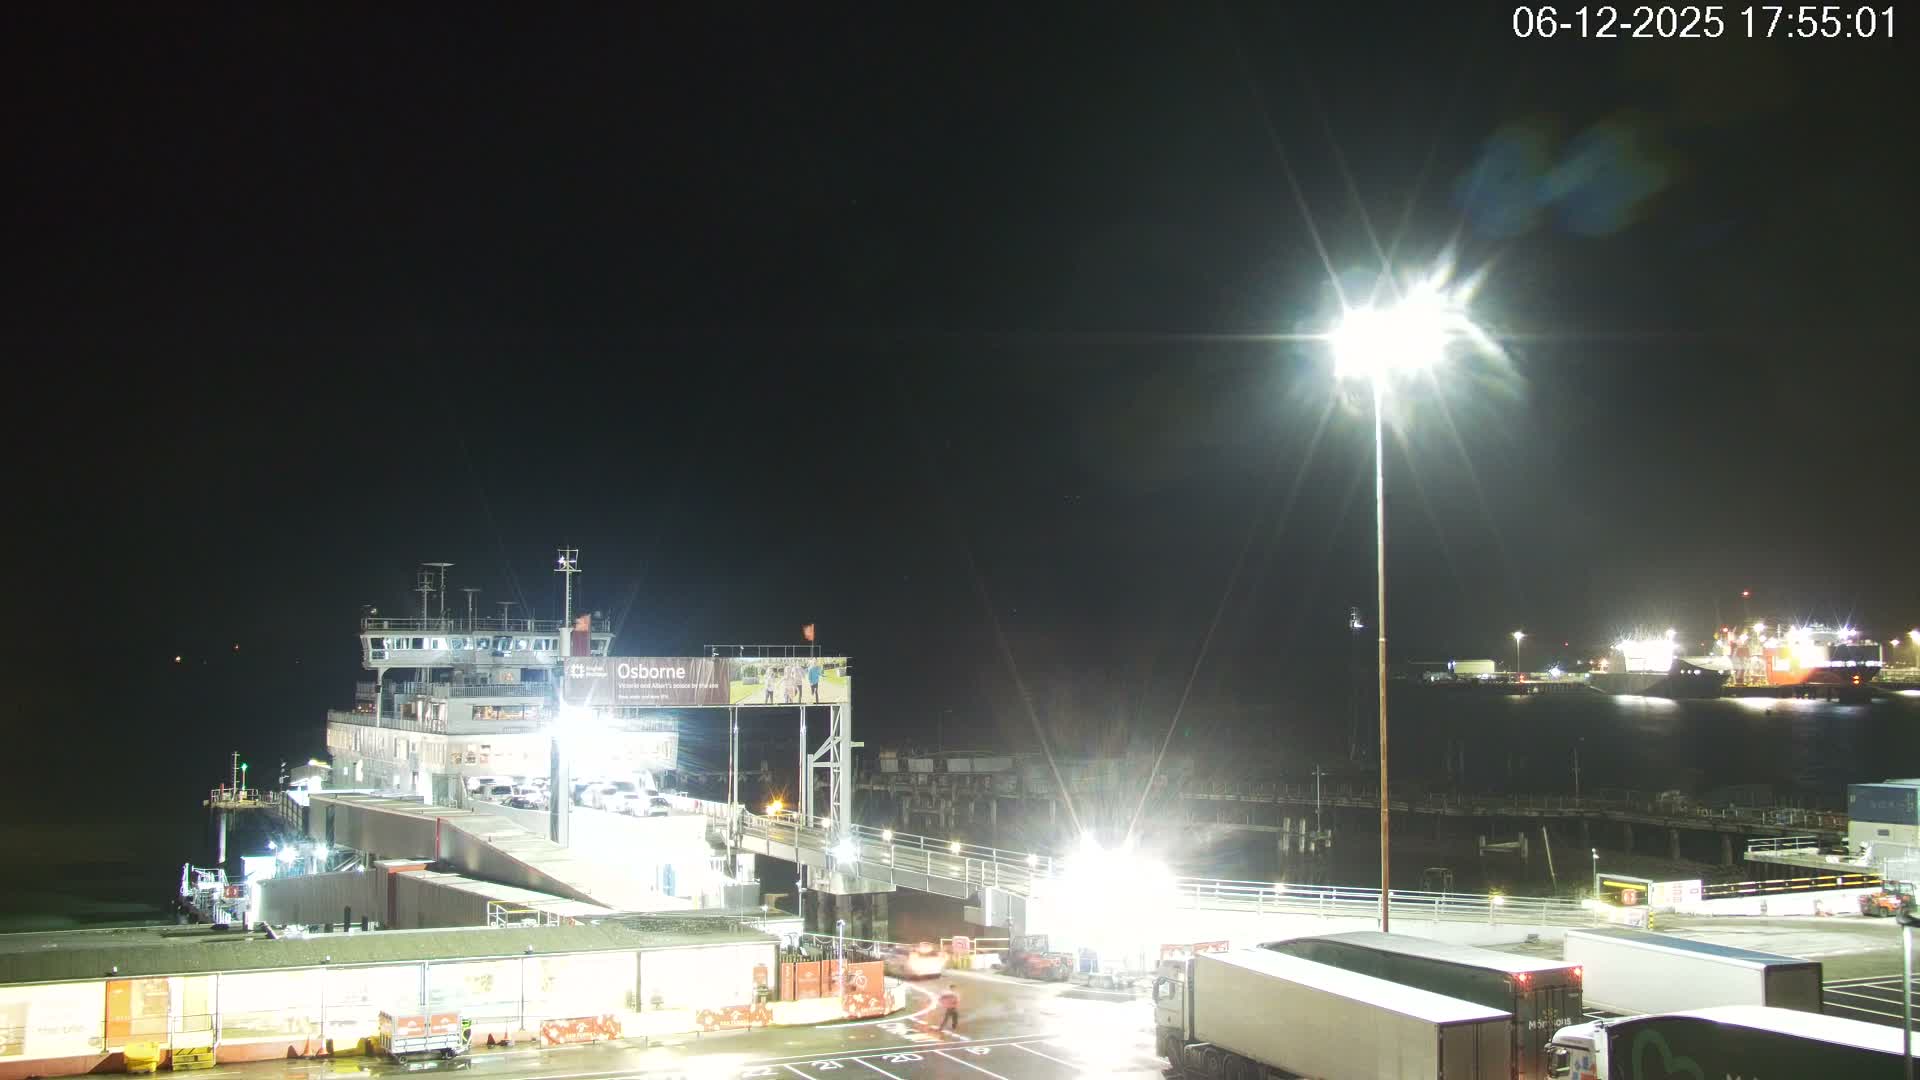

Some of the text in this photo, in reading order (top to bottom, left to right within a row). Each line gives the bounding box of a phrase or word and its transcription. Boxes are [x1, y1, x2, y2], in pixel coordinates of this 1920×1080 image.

[617, 663, 686, 679] Osborne
[882, 1053, 924, 1063] 20
[811, 1060, 845, 1071] 21
